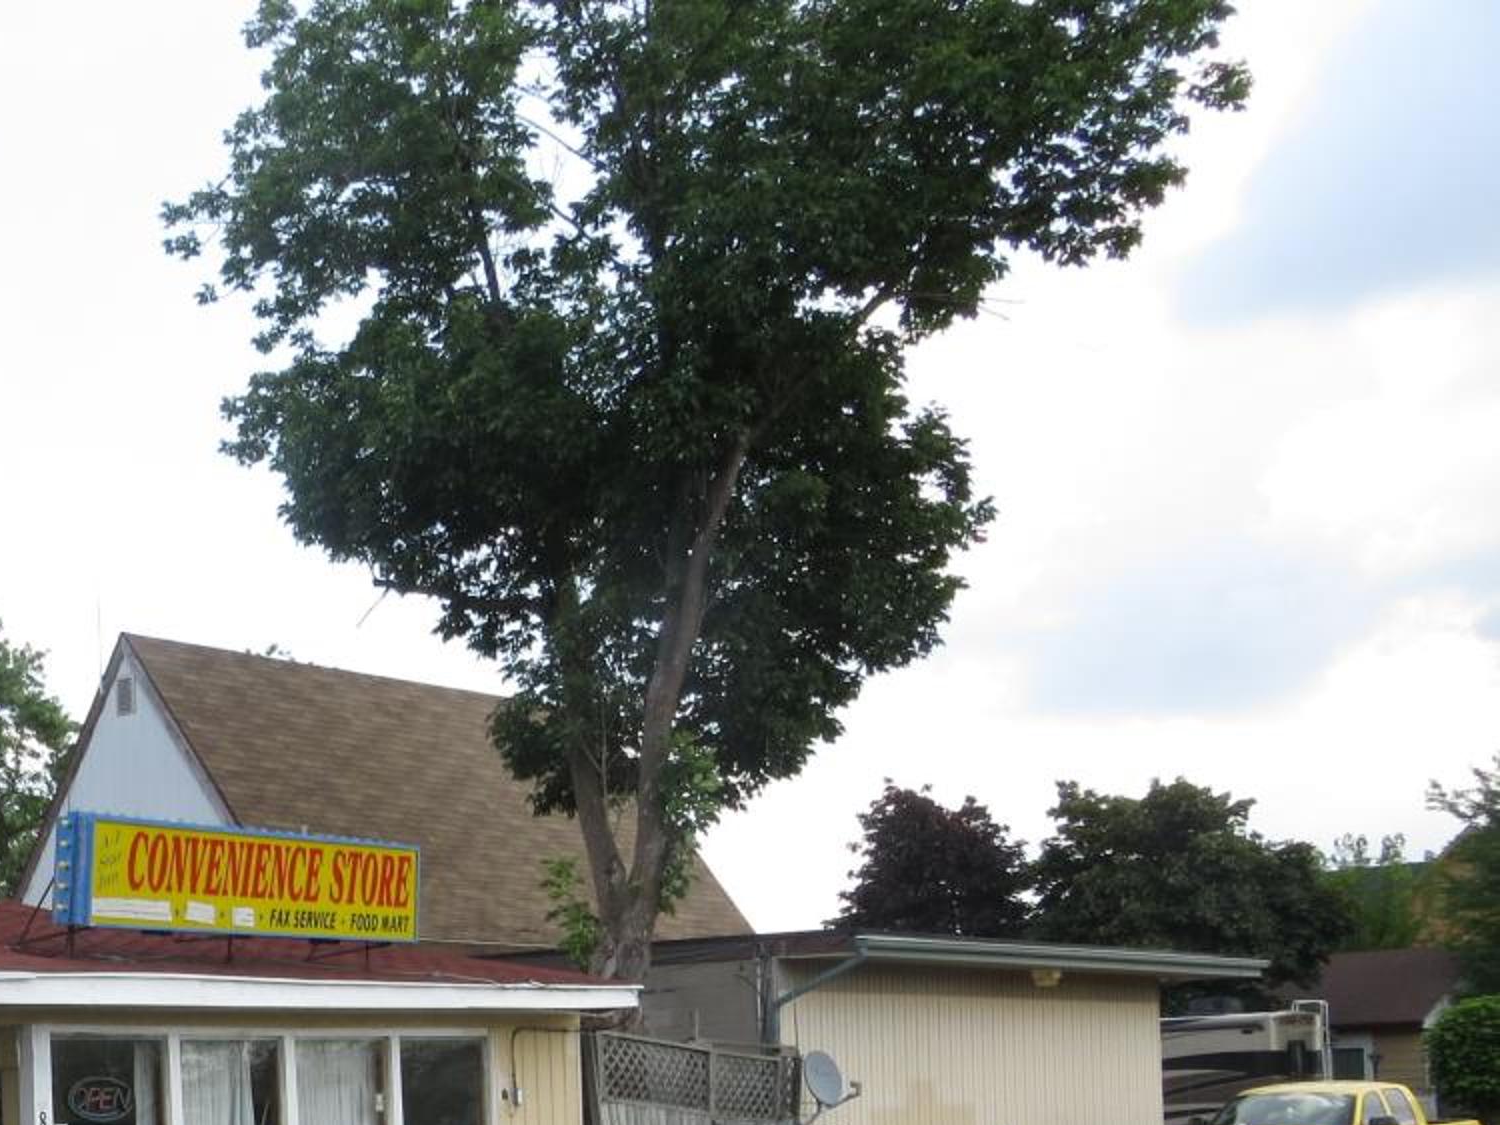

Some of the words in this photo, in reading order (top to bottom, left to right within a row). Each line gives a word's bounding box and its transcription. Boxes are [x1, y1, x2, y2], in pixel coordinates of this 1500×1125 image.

[127, 831, 324, 902] CONVENIENCE
[329, 849, 412, 908] STORE
[269, 908, 291, 928] FAX
[292, 910, 336, 930] SERVICE
[350, 912, 379, 932] FOOD
[381, 914, 409, 933] MART
